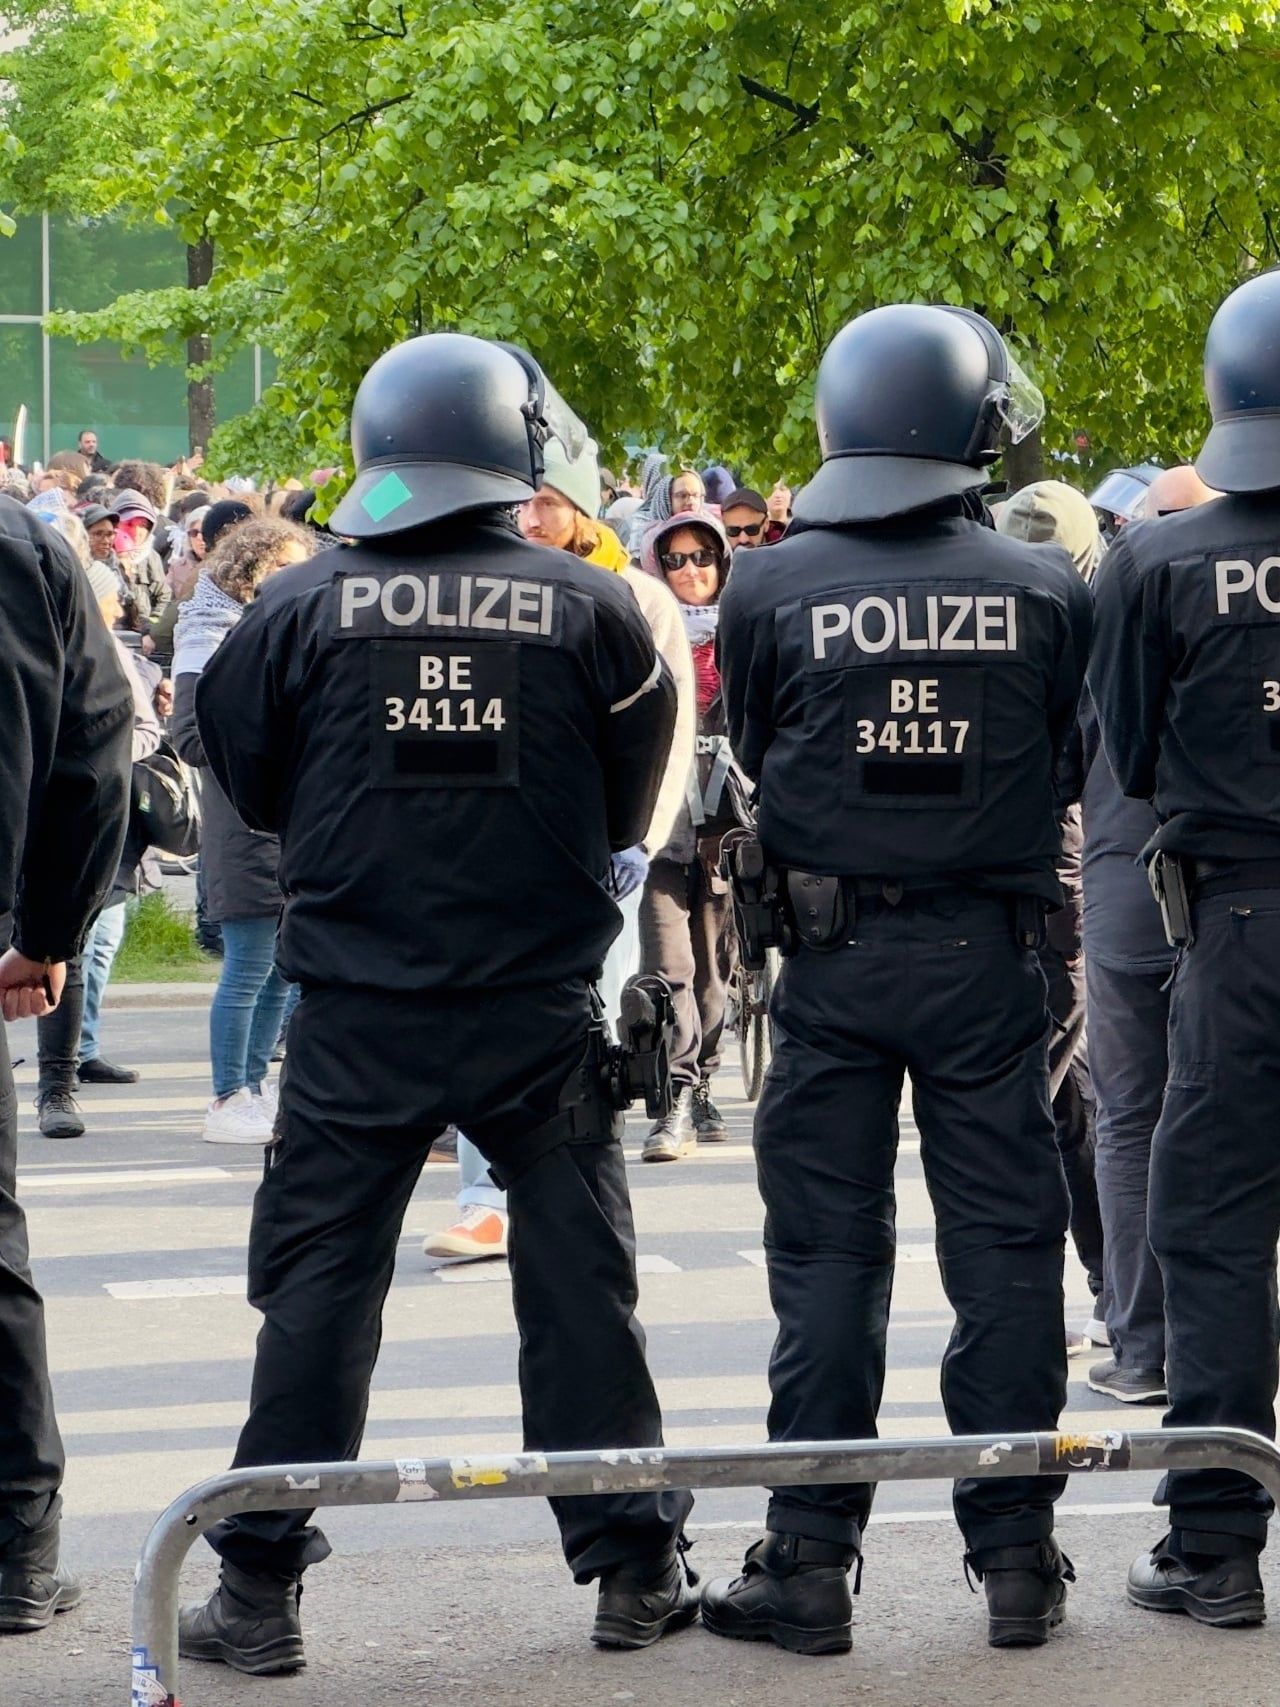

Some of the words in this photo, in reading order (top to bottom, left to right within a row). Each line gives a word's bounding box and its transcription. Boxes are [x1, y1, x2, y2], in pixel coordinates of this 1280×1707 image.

[341, 575, 553, 635] POLIZEI
[812, 596, 1016, 659] POLIZEI
[420, 656, 471, 690] BE
[891, 680, 938, 713] BE
[386, 698, 505, 731] 34114
[857, 720, 969, 753] 34117
